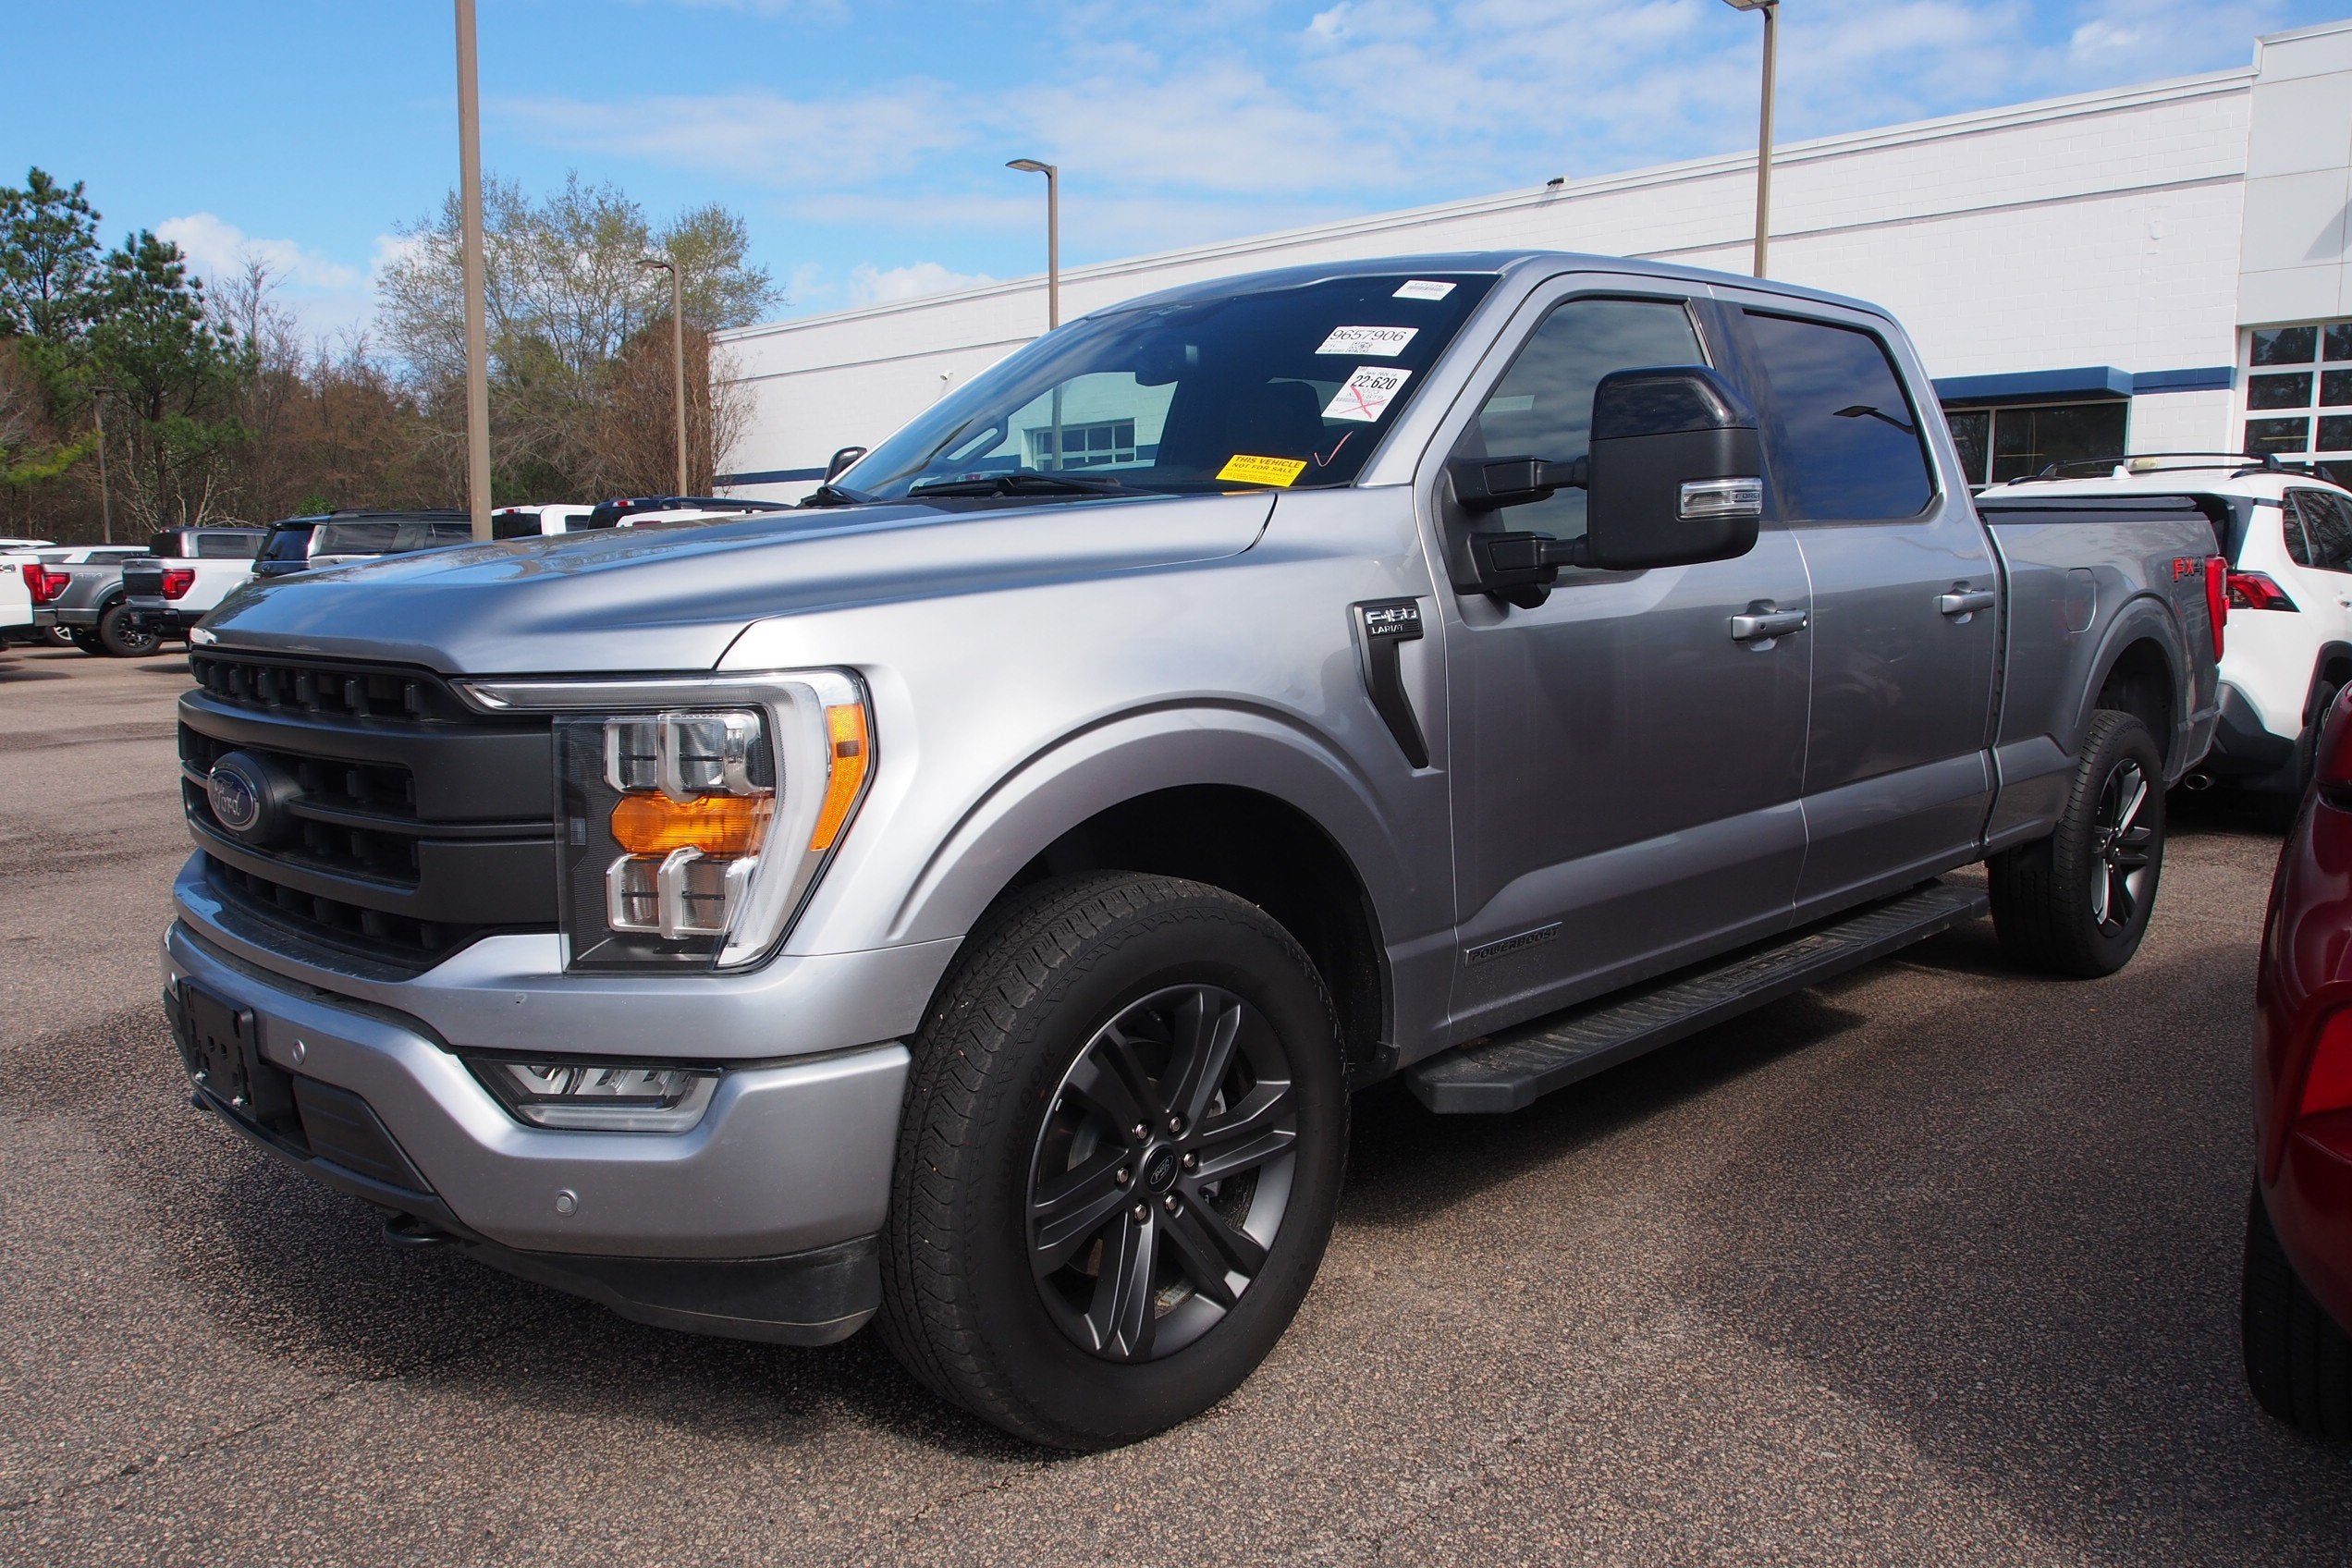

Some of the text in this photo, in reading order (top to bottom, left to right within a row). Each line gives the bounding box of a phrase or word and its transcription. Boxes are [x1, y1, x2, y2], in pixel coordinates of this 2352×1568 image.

[1329, 329, 1407, 342] 9657906
[1351, 374, 1398, 390] 22:620
[1234, 456, 1303, 469] THIS VEHICLE
[2173, 556, 2203, 582] FX4
[1366, 608, 1418, 624] F-150
[1371, 624, 1404, 634] LARIAT
[214, 777, 243, 817] Ford
[1471, 927, 1560, 962] POWERBOOST
[1154, 1158, 1171, 1182] Ford
